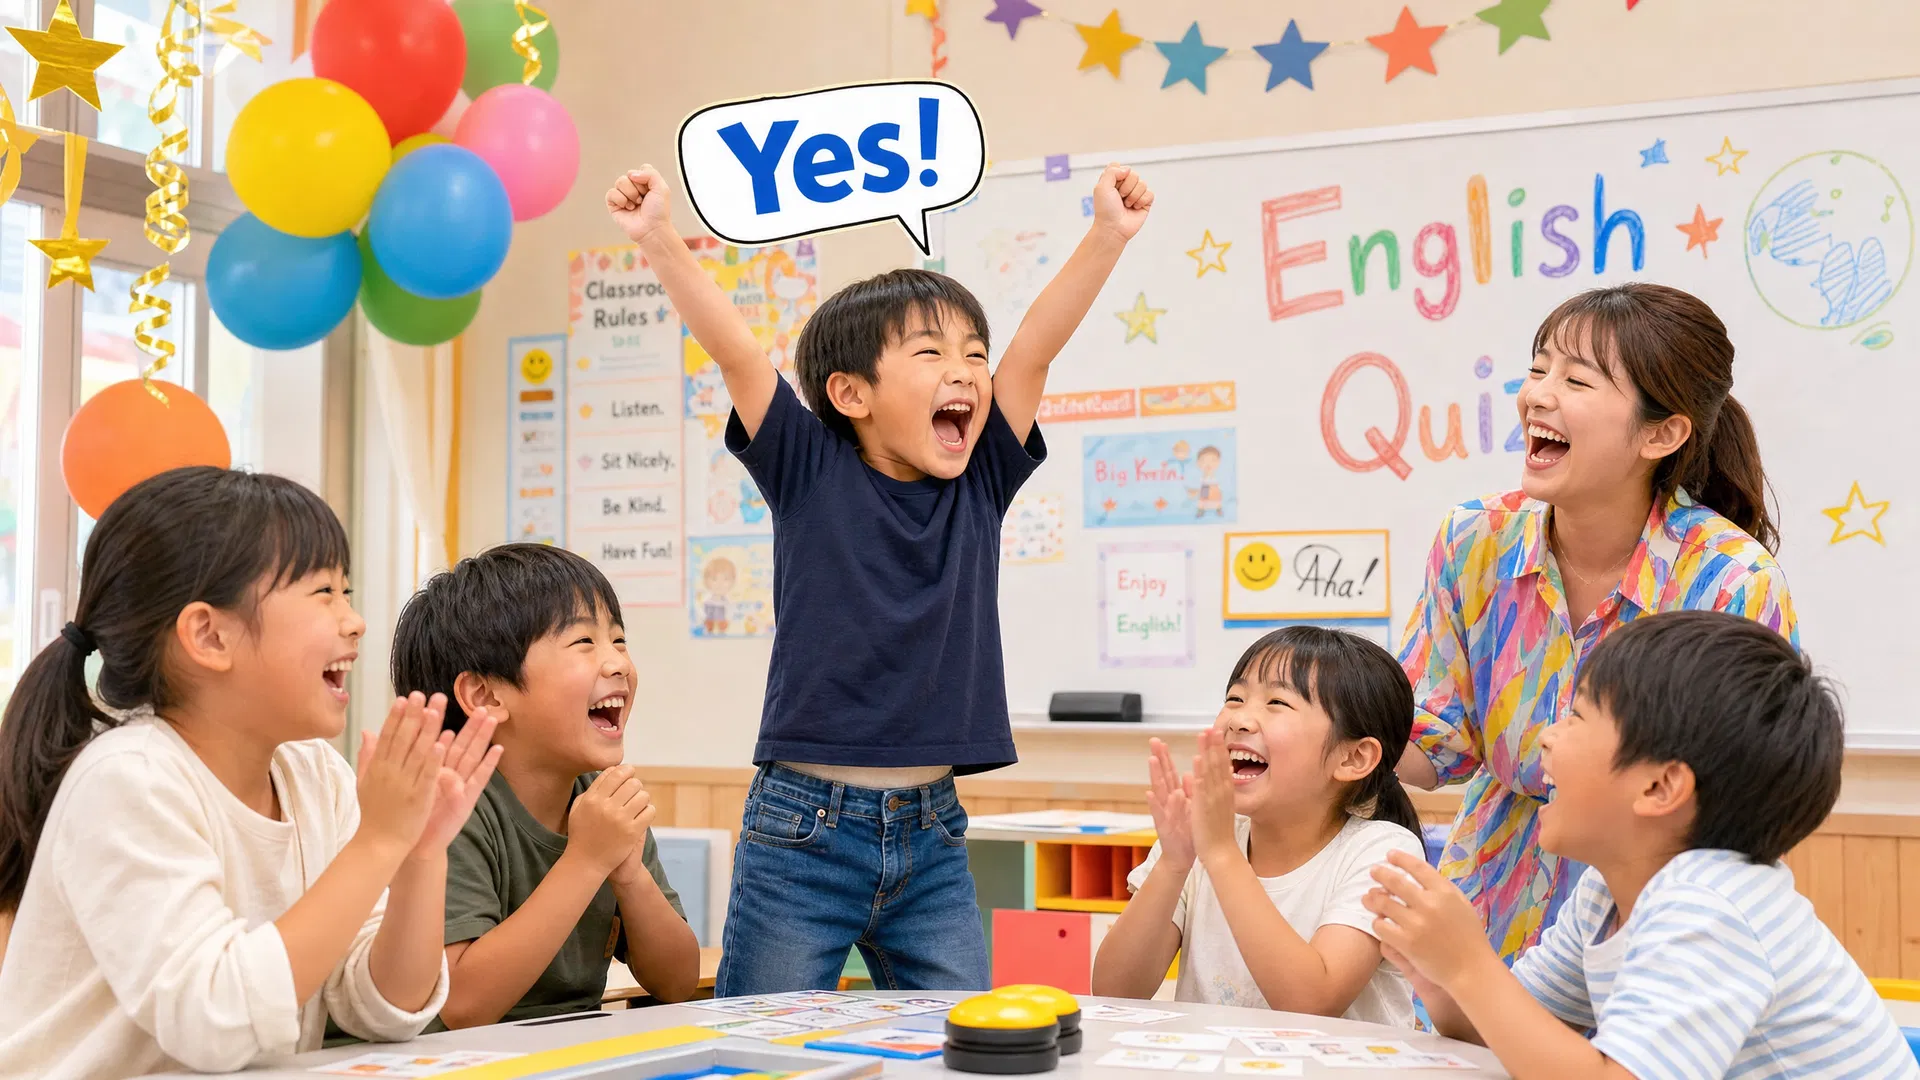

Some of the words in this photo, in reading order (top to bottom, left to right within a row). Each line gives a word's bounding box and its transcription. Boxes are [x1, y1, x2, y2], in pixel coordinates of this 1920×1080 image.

[1262, 172, 1645, 322] English
[586, 280, 665, 300] Classroo
[594, 307, 648, 328] Rules
[611, 401, 664, 417] Listen.
[601, 453, 621, 470] Sit
[626, 451, 675, 471] Nicely.
[1095, 459, 1128, 486] Big
[602, 499, 620, 515] Be
[628, 497, 666, 513] Kind.
[602, 544, 636, 559] Have
[641, 541, 672, 559] Fun!
[1293, 544, 1378, 597] Aha!
[1117, 569, 1167, 599] Enjoy
[1117, 613, 1181, 640] English!
